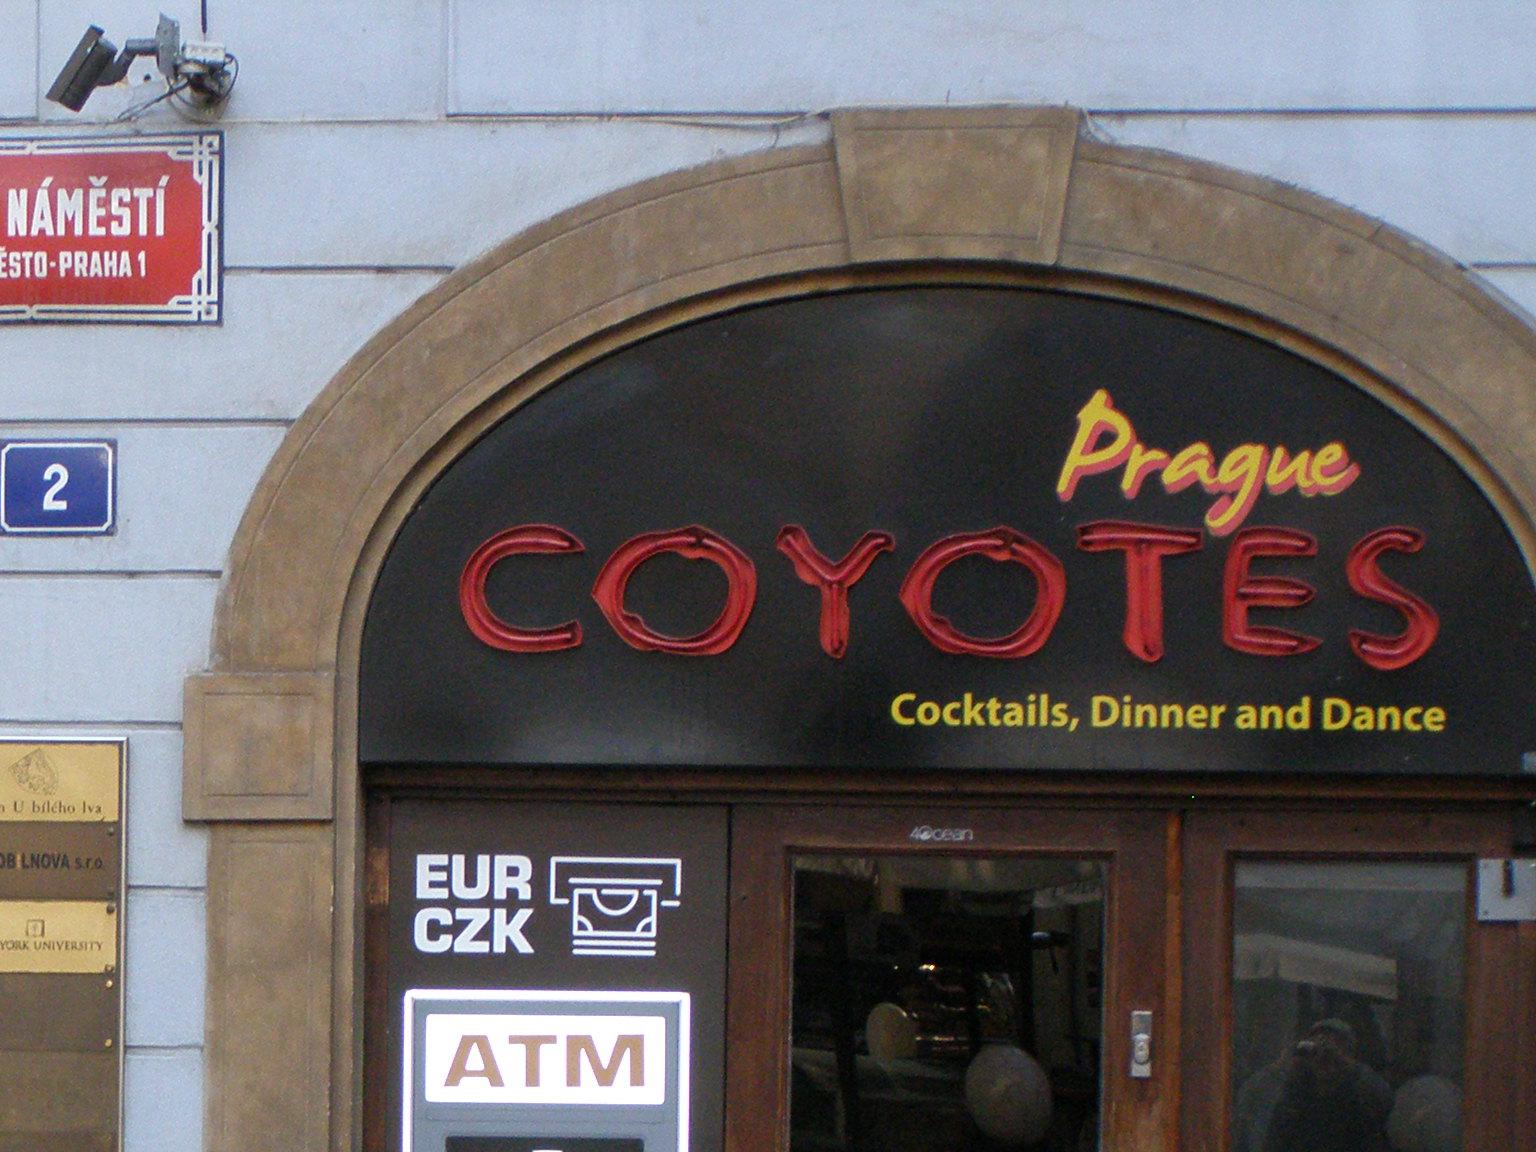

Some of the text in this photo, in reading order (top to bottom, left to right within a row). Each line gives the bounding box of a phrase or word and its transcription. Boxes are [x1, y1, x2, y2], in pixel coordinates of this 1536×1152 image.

[7, 175, 170, 238] NÁMĚSTÍ
[138, 250, 146, 277] 1
[1057, 388, 1361, 537] Prague
[42, 463, 69, 511] 2
[458, 521, 1440, 671] COYOTES
[891, 692, 1447, 732] Cocktails, Dinner and Dance
[14, 801, 24, 813] U
[32, 800, 76, 814] bílého
[416, 854, 533, 900] EUR
[0, 940, 29, 951] YORK
[34, 941, 104, 951] UNIVERSITY
[414, 907, 535, 954] CZK
[444, 1034, 645, 1088] ATM
